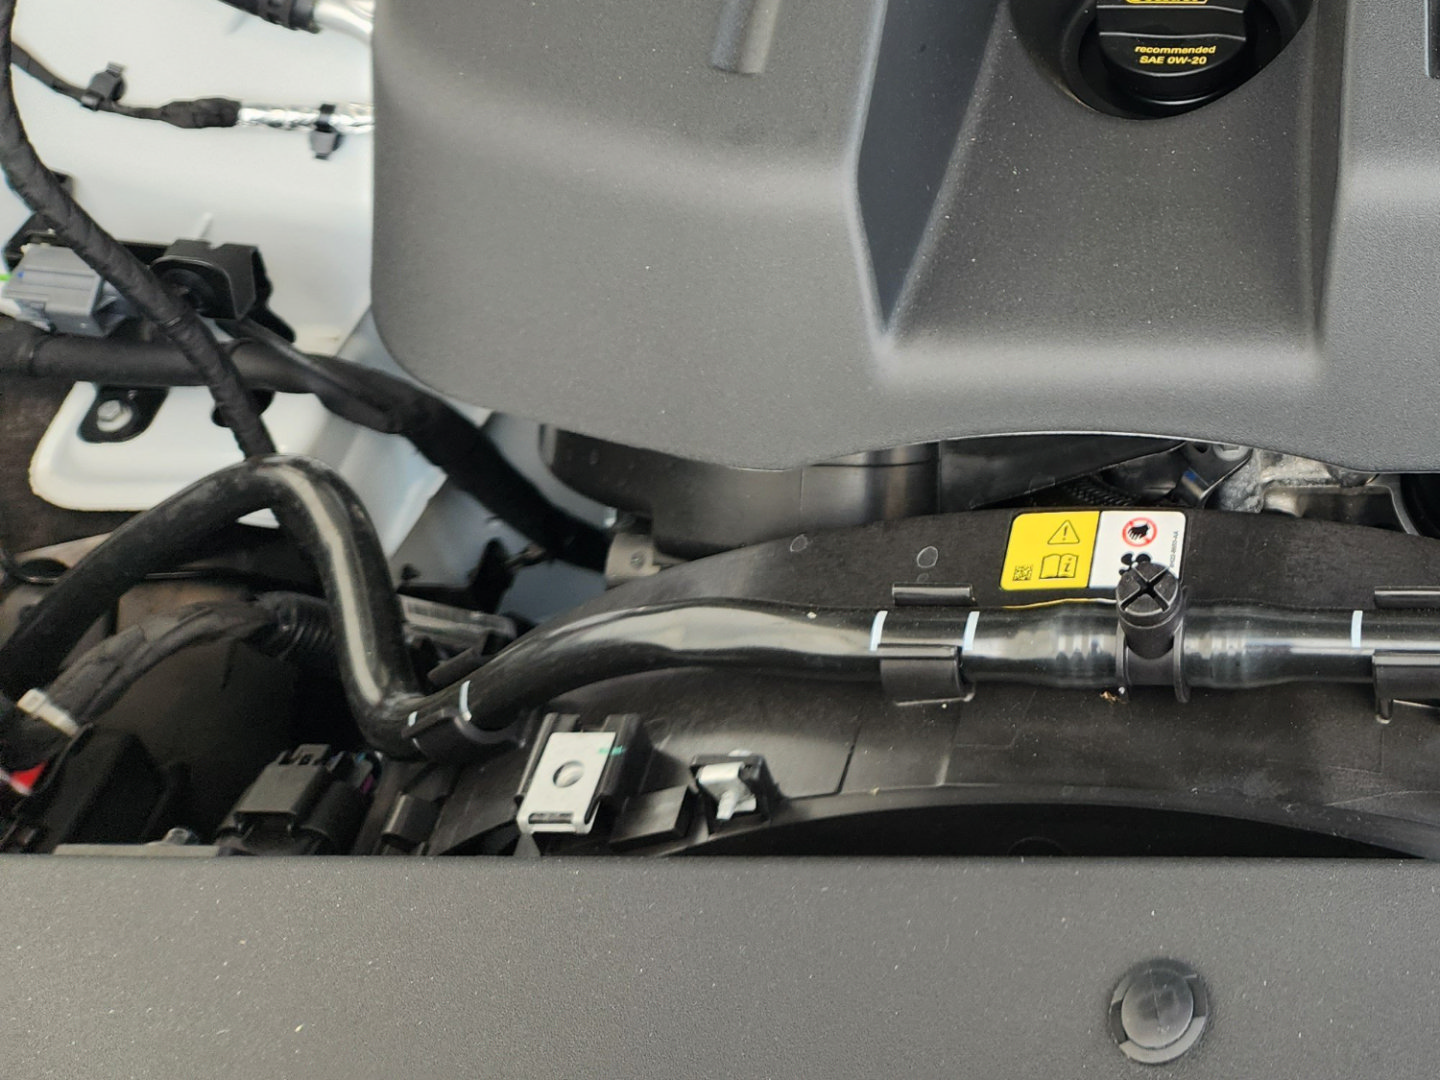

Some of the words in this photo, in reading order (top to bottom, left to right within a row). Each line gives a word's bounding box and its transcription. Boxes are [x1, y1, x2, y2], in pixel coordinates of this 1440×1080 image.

[1134, 45, 1217, 55] recommended
[1139, 55, 1165, 65] SAE
[1167, 56, 1208, 65] 0W-20
